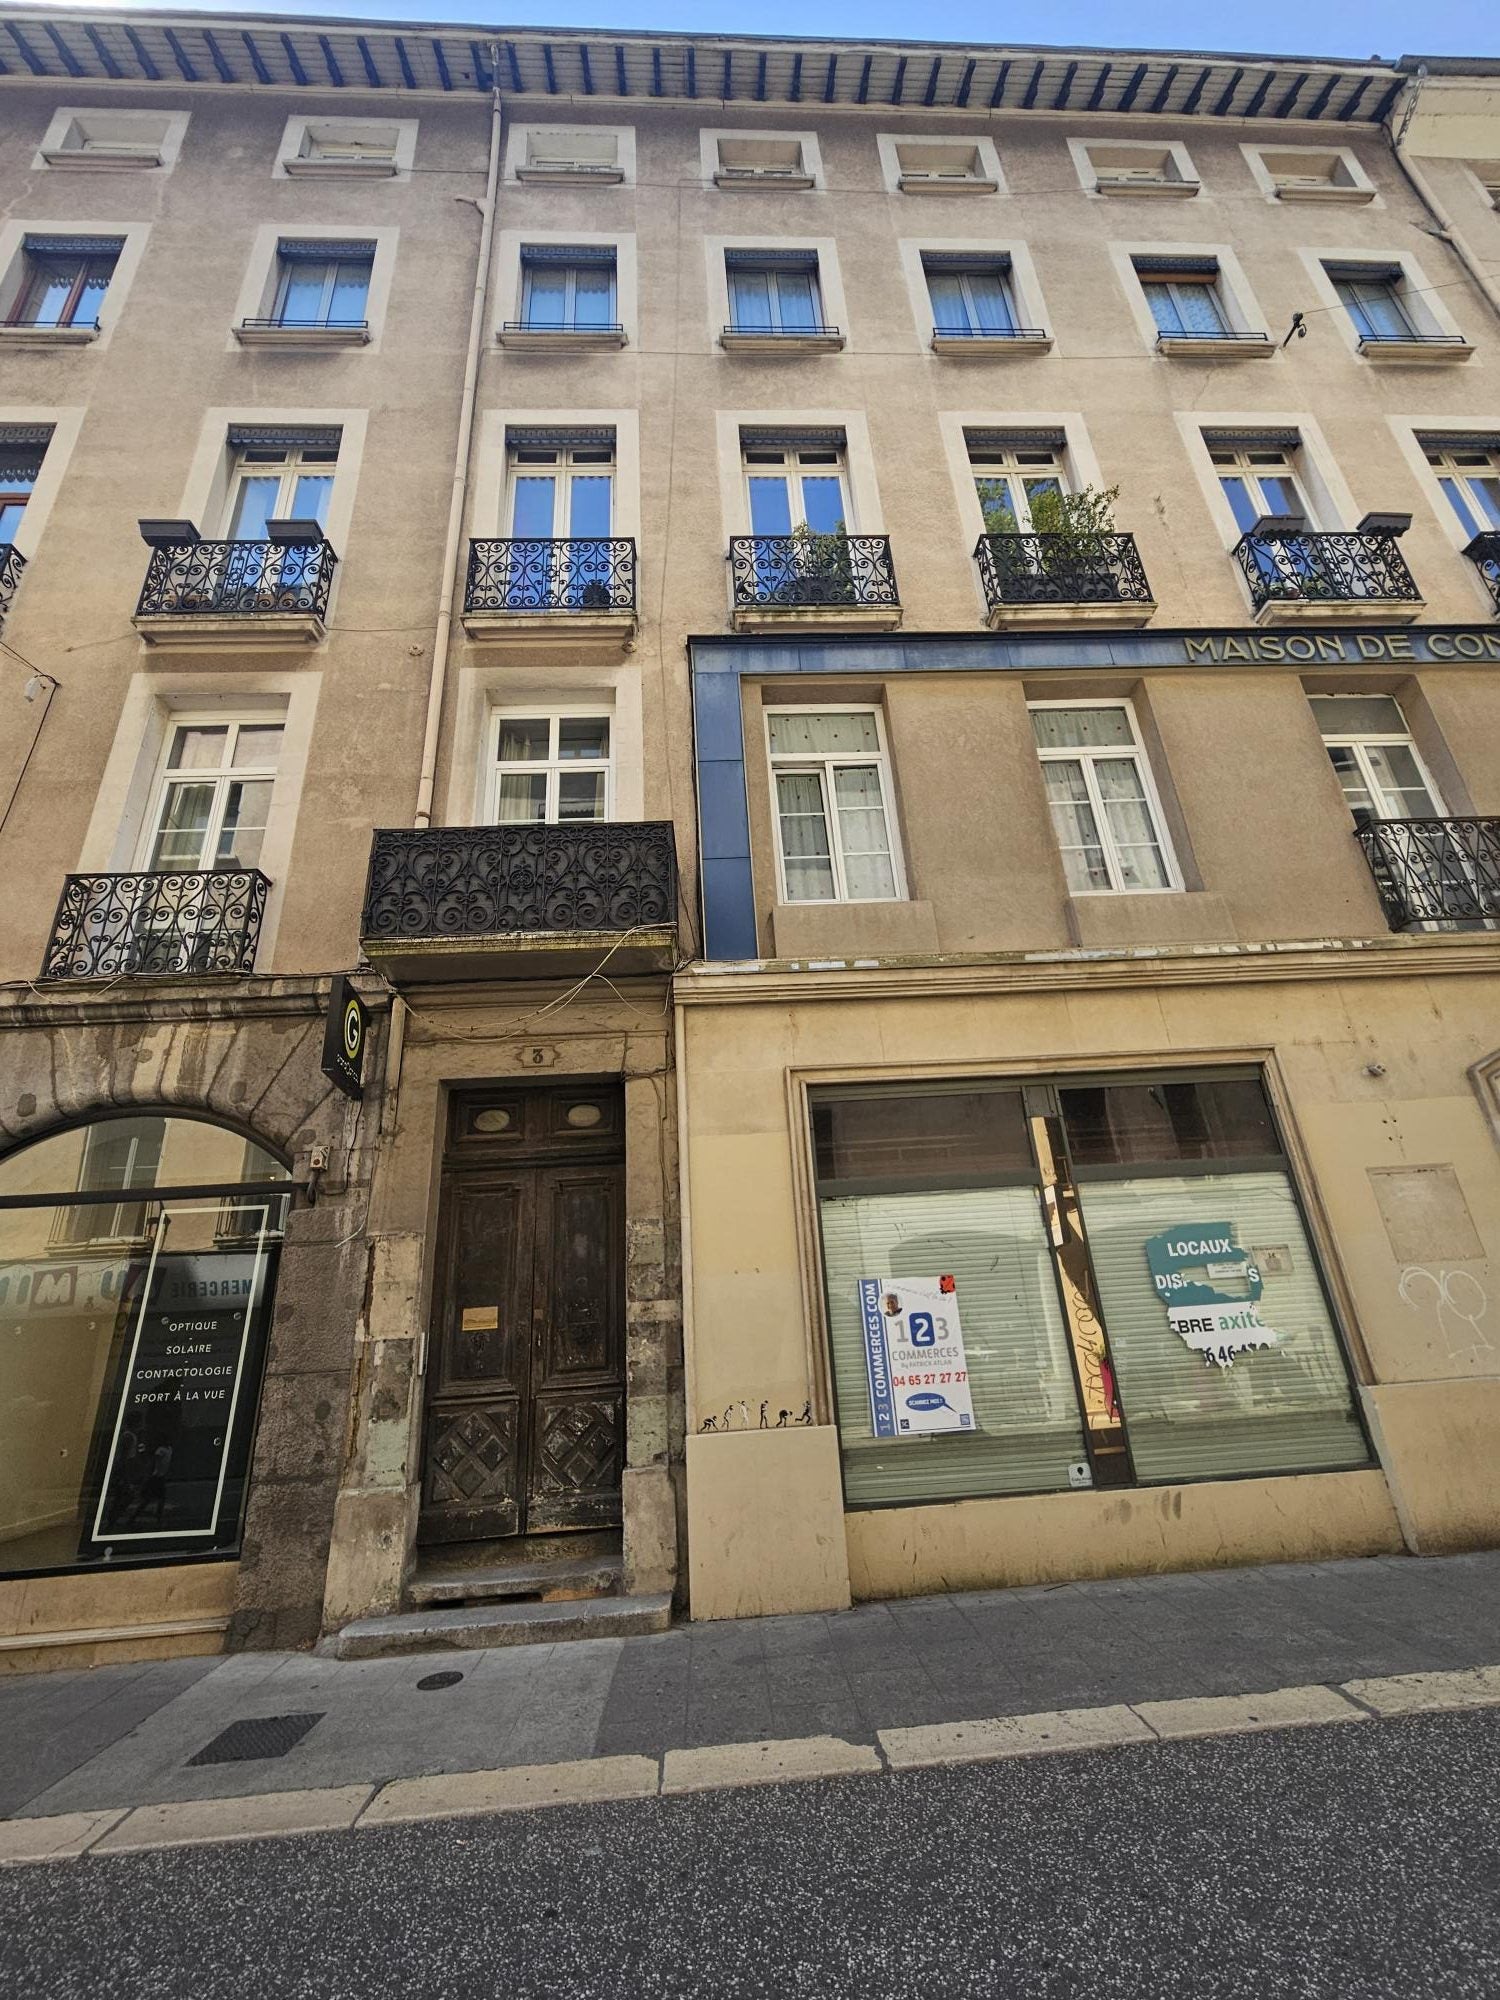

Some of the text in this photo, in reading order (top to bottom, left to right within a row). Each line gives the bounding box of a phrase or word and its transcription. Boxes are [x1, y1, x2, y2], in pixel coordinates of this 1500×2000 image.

[1184, 634, 1347, 661] MAISON
[1356, 633, 1416, 659] DE
[532, 1048, 544, 1064] 3
[1167, 1239, 1232, 1257] LOCAUX
[169, 1321, 218, 1332] OPTIQUE
[166, 1344, 212, 1355] SOLAIRE
[892, 1346, 959, 1361] COMMERCES
[136, 1366, 233, 1379] CONTACTOLOGIE
[893, 1371, 966, 1387] 04 65 27 27 27
[134, 1389, 226, 1403] SPORT À LA VUE
